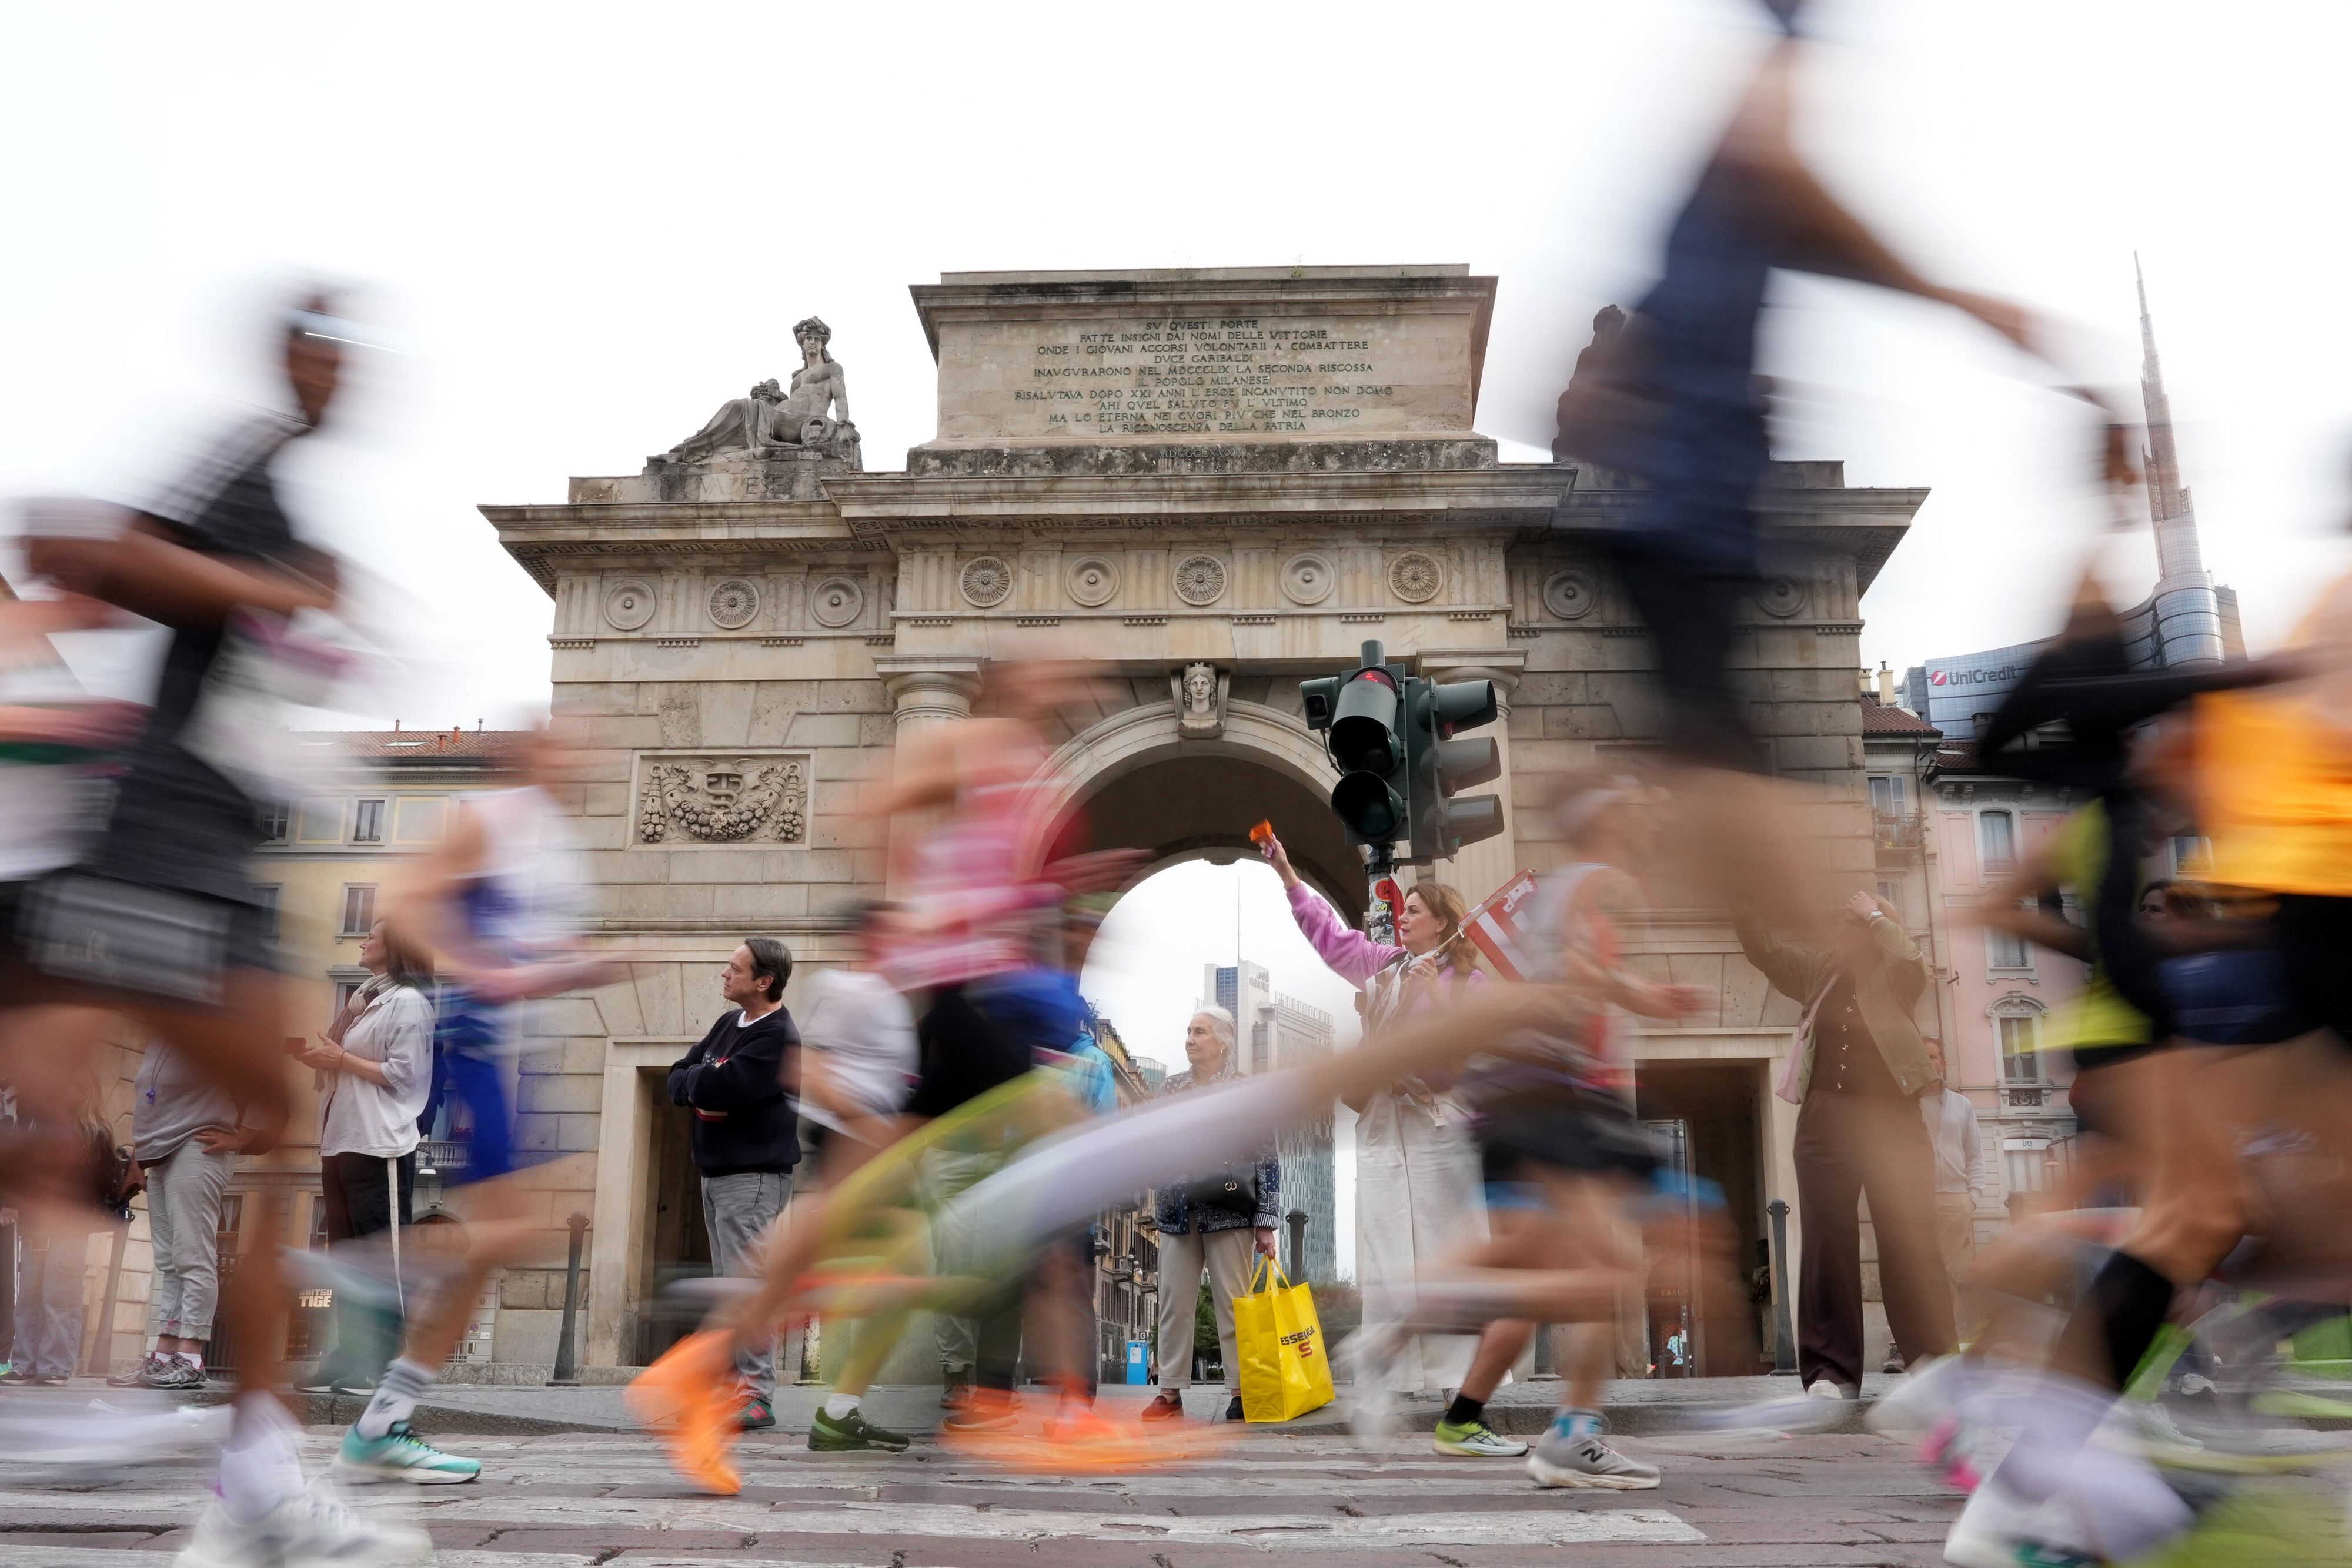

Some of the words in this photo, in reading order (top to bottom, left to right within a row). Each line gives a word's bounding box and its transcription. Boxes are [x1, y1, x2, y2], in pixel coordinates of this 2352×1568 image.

[1220, 320, 1258, 329] PORTE
[1167, 333, 1185, 341] DAI
[1228, 332, 1263, 340] DELLE
[1269, 330, 1327, 339] VITTORIE
[1077, 346, 1080, 354] I
[1087, 345, 1133, 353] GIOVANI
[1141, 344, 1187, 352] ACCORSI
[1194, 343, 1266, 351] VOLONTARII
[1291, 341, 1368, 350] COMBATTERE
[1155, 355, 1185, 363] DVCE
[1192, 354, 1252, 363] GARIBALDI
[1034, 368, 1131, 377] INAVGVRARONO
[1139, 366, 1161, 375] NEL
[1168, 365, 1229, 375] MDCCCLIX
[1237, 365, 1251, 373] LA
[1259, 365, 1312, 373] SECONDA
[1319, 363, 1373, 372] RISCOSSA
[1138, 378, 1148, 387] IL
[1155, 377, 1204, 386] POPOLO
[1211, 376, 1268, 385] MILANESE
[1015, 390, 1083, 400] RISALVTAVA
[1090, 390, 1122, 399] DOPO
[1131, 389, 1151, 398] XXI
[1158, 389, 1185, 397] ANNI
[1242, 387, 1317, 396] INCANVTITO
[1325, 386, 1350, 395] NON
[1099, 402, 1119, 410] AHI
[1128, 400, 1160, 410] QVEL
[1168, 399, 1217, 409] SALVTO
[1049, 413, 1067, 422] MA
[1075, 413, 1091, 422] LO
[1099, 412, 1146, 421] ETERNA
[1154, 412, 1171, 420] NEI
[1178, 411, 1217, 420] CVORI
[1252, 410, 1275, 419] CHE
[1282, 410, 1306, 418] NEL
[1312, 409, 1360, 418] BRONZO
[1100, 424, 1114, 433] LA
[1122, 423, 1211, 433] RICONOSCENZA
[1219, 422, 1257, 431] DELLA
[1264, 421, 1305, 430] PATRIA
[1950, 666, 2017, 685] UniCredit
